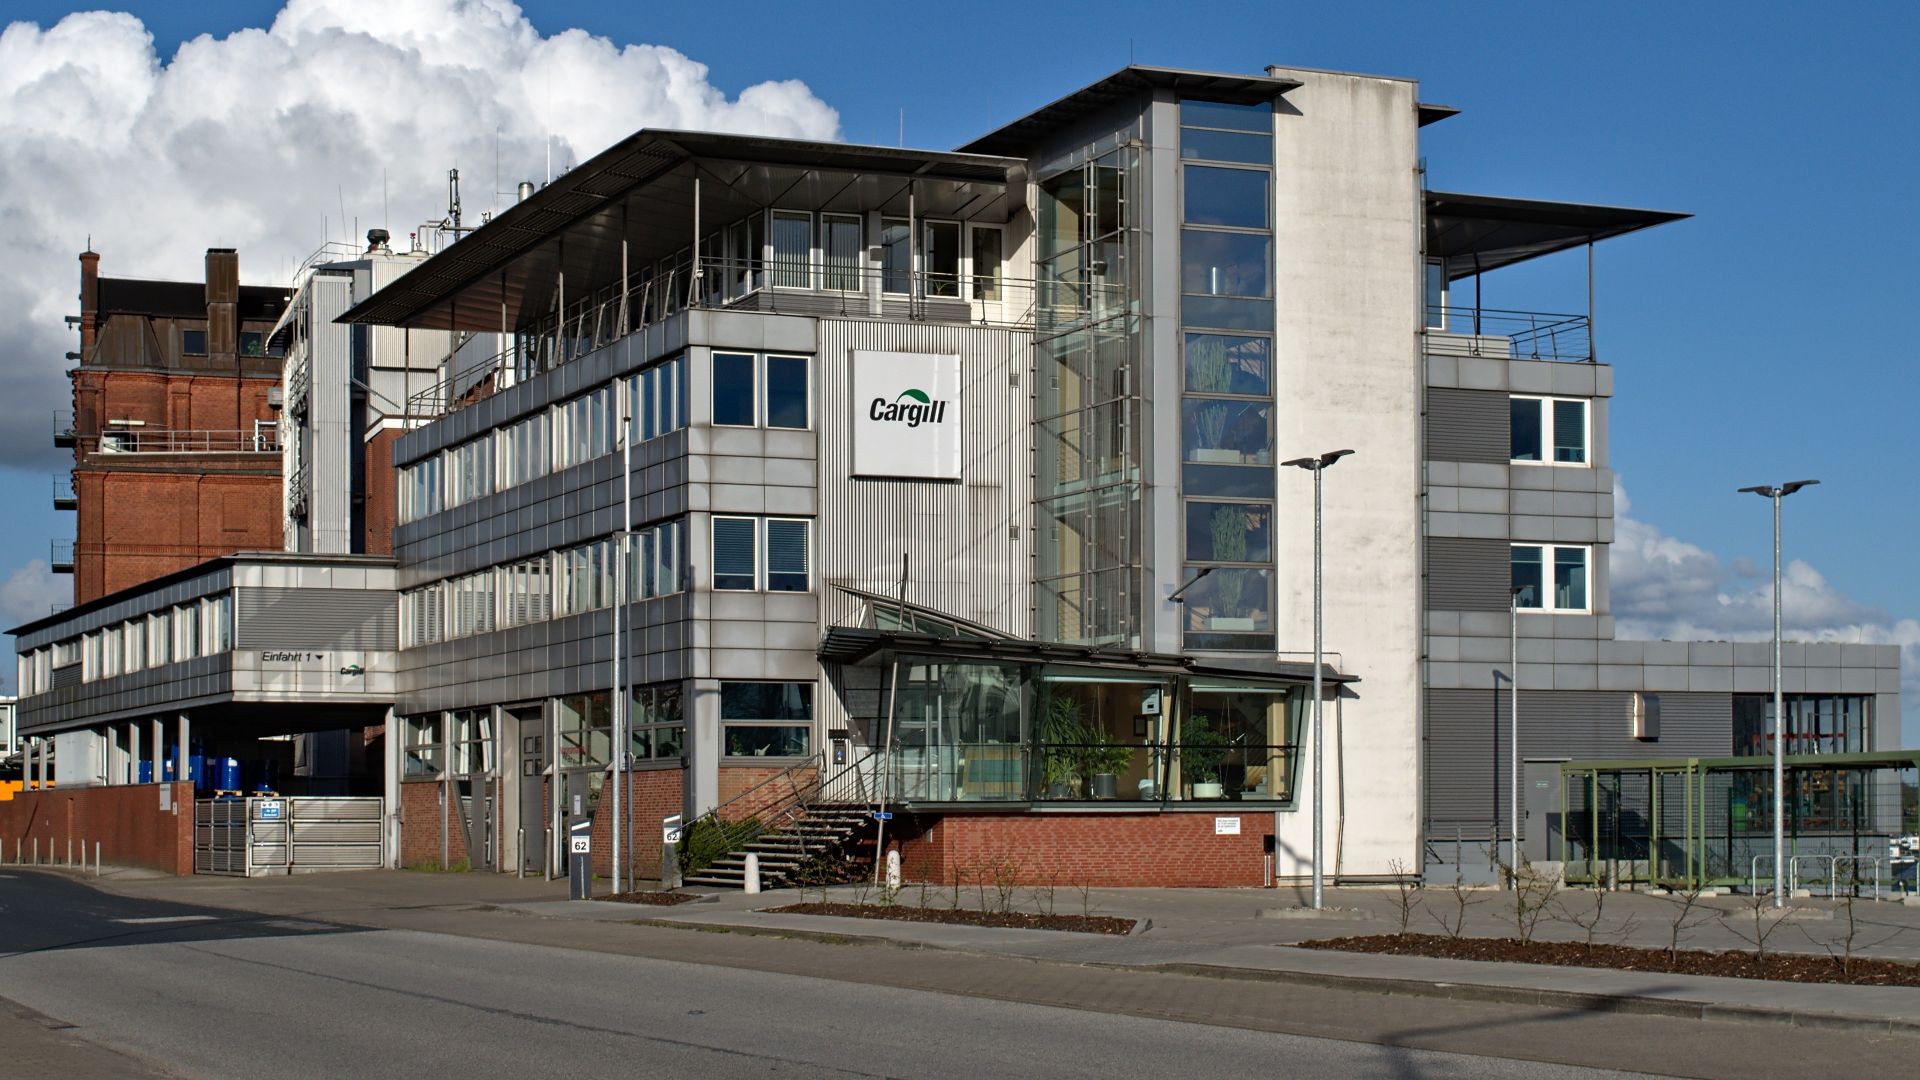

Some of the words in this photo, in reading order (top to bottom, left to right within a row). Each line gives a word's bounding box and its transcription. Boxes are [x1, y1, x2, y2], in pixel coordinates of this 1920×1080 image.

[870, 397, 945, 428] Cargill
[262, 651, 302, 662] Einfahrt
[306, 653, 311, 662] 1
[667, 832, 677, 841] 62
[574, 841, 587, 851] 62
